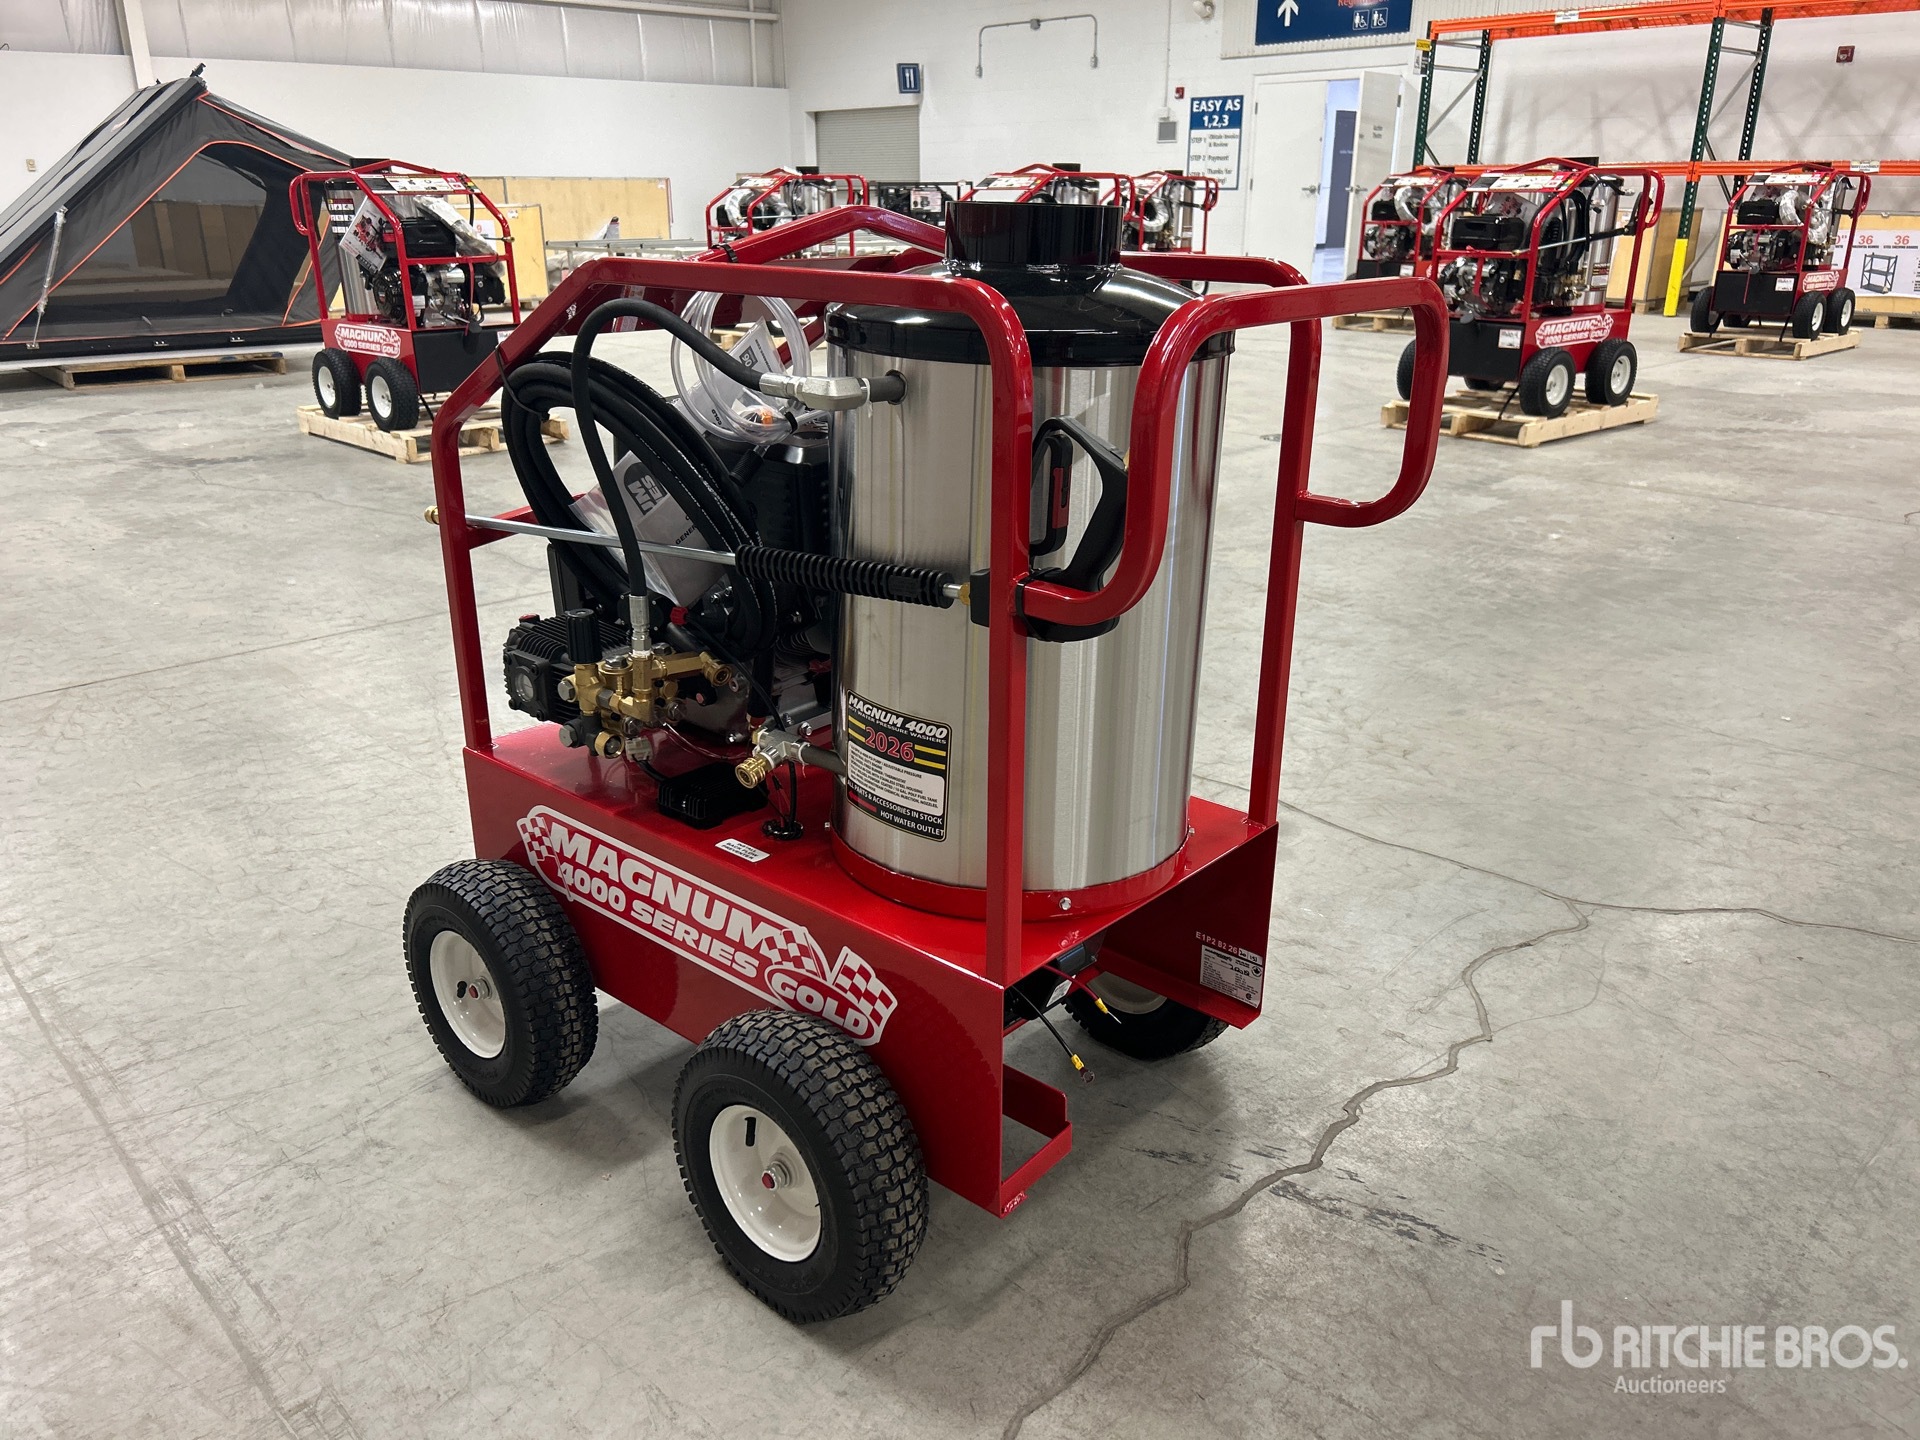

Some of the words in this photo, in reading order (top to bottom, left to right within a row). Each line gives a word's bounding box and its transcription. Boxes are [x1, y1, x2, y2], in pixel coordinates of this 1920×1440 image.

[1192, 100, 1222, 112] EASY
[1224, 98, 1241, 111] AS
[1202, 114, 1230, 128] 1,2,3
[1208, 154, 1229, 162] Payment
[1858, 234, 1874, 244] 36
[1894, 234, 1910, 245] 36
[340, 327, 384, 344] MAGNUM
[1544, 320, 1592, 336] MAGNUM
[1562, 332, 1590, 342] SERIES
[358, 341, 380, 352] SERIES
[848, 694, 904, 728] MAGNUM
[905, 720, 948, 739] 4000
[857, 710, 875, 723] WATER
[876, 718, 908, 736] PRESSURE
[910, 732, 946, 744] WASHERS
[865, 726, 914, 762] 2026
[903, 769, 921, 779] PRESSURE
[895, 781, 905, 789] STEEL
[905, 785, 922, 794] HOUSING
[907, 790, 917, 798] POLY
[854, 784, 868, 798] PARTS
[872, 795, 910, 816] ACCESSORIES
[912, 810, 918, 818] IN
[920, 814, 943, 825] STOCK
[880, 810, 892, 820] HOT
[894, 815, 916, 829] WATER
[916, 823, 944, 837] OUTLET
[551, 822, 775, 959] MAGNUM
[557, 862, 626, 912] 4000
[630, 898, 760, 978] SERIES
[771, 971, 869, 1036] GOLD
